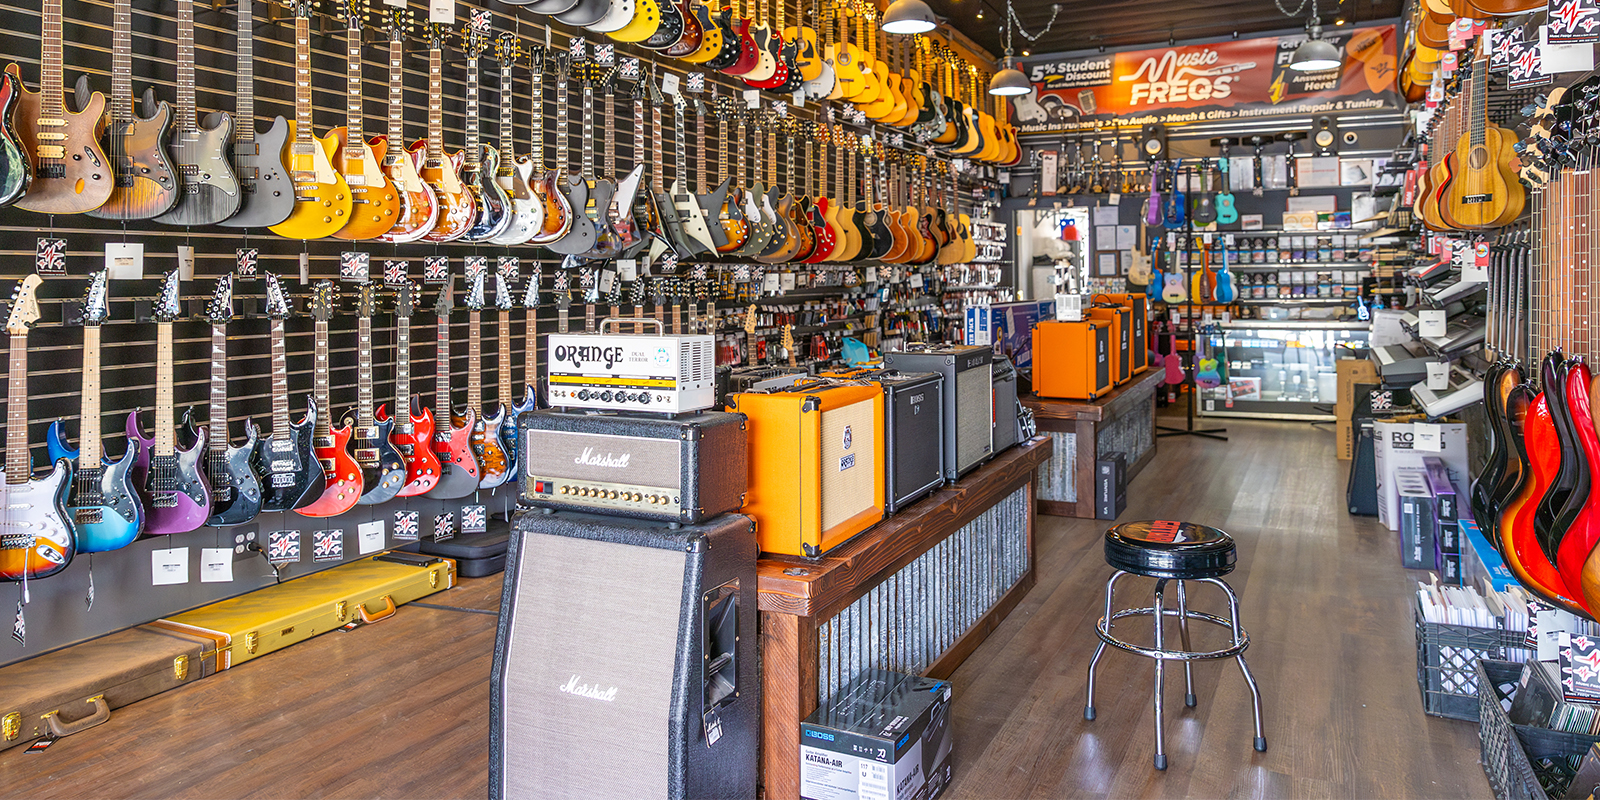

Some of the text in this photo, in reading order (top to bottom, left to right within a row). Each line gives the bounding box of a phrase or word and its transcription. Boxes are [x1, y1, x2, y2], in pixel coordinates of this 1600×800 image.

[1281, 40, 1298, 49] Get
[1030, 58, 1112, 82] 5% Student
[1065, 70, 1111, 82] Discount
[1118, 48, 1218, 86] Music
[1292, 72, 1338, 83] Answered
[1130, 76, 1233, 106] FREQS
[1304, 80, 1336, 91] Here!
[1022, 122, 1047, 132] Music
[1129, 114, 1158, 125] Audio
[1167, 112, 1198, 122] Merch
[1199, 112, 1206, 120] &
[1207, 109, 1231, 120] Gifts
[1239, 106, 1297, 116] Instrument
[1299, 102, 1335, 113] Repair
[1335, 101, 1343, 109] &
[1345, 98, 1384, 109] Tuning
[555, 345, 624, 369] ORANGE
[574, 447, 630, 468] Marshall
[559, 674, 618, 702] Marshall
[811, 730, 835, 742] BOSS
[805, 754, 843, 768] KATANA-AIR
